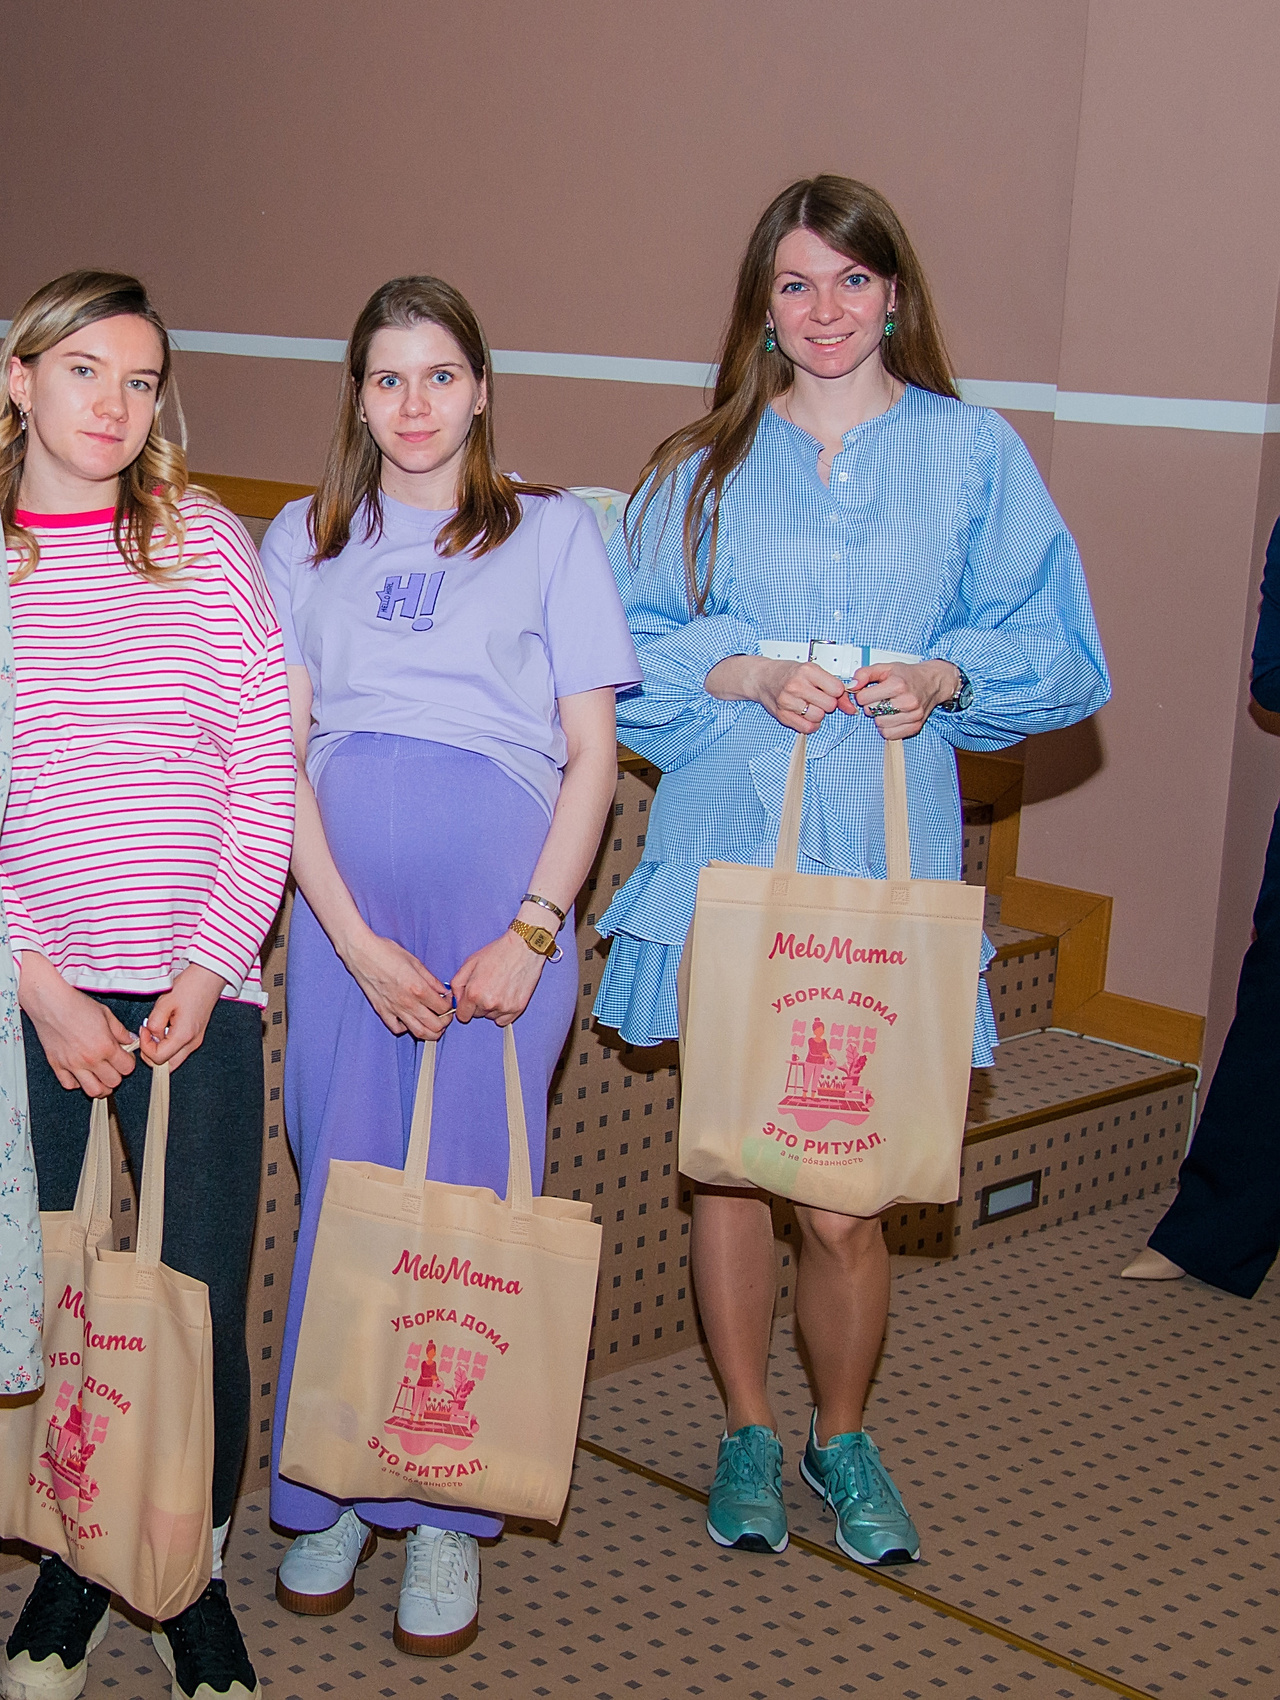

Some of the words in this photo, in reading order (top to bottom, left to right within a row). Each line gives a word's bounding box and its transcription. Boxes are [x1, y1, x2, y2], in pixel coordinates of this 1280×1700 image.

[768, 931, 908, 966] MeloMama
[771, 987, 844, 1014] УБОРКА
[847, 991, 898, 1026] ДОМА
[762, 1122, 798, 1148] ЭТО
[788, 1153, 799, 1161] не
[802, 1157, 864, 1166] обязанность
[391, 1249, 523, 1296] MeloMama
[391, 1308, 458, 1332] УБОРКА
[460, 1313, 510, 1355] ДОМА
[83, 1375, 132, 1415] ДОМА
[367, 1436, 400, 1466] ЭТО
[28, 1473, 57, 1501] ЭТО
